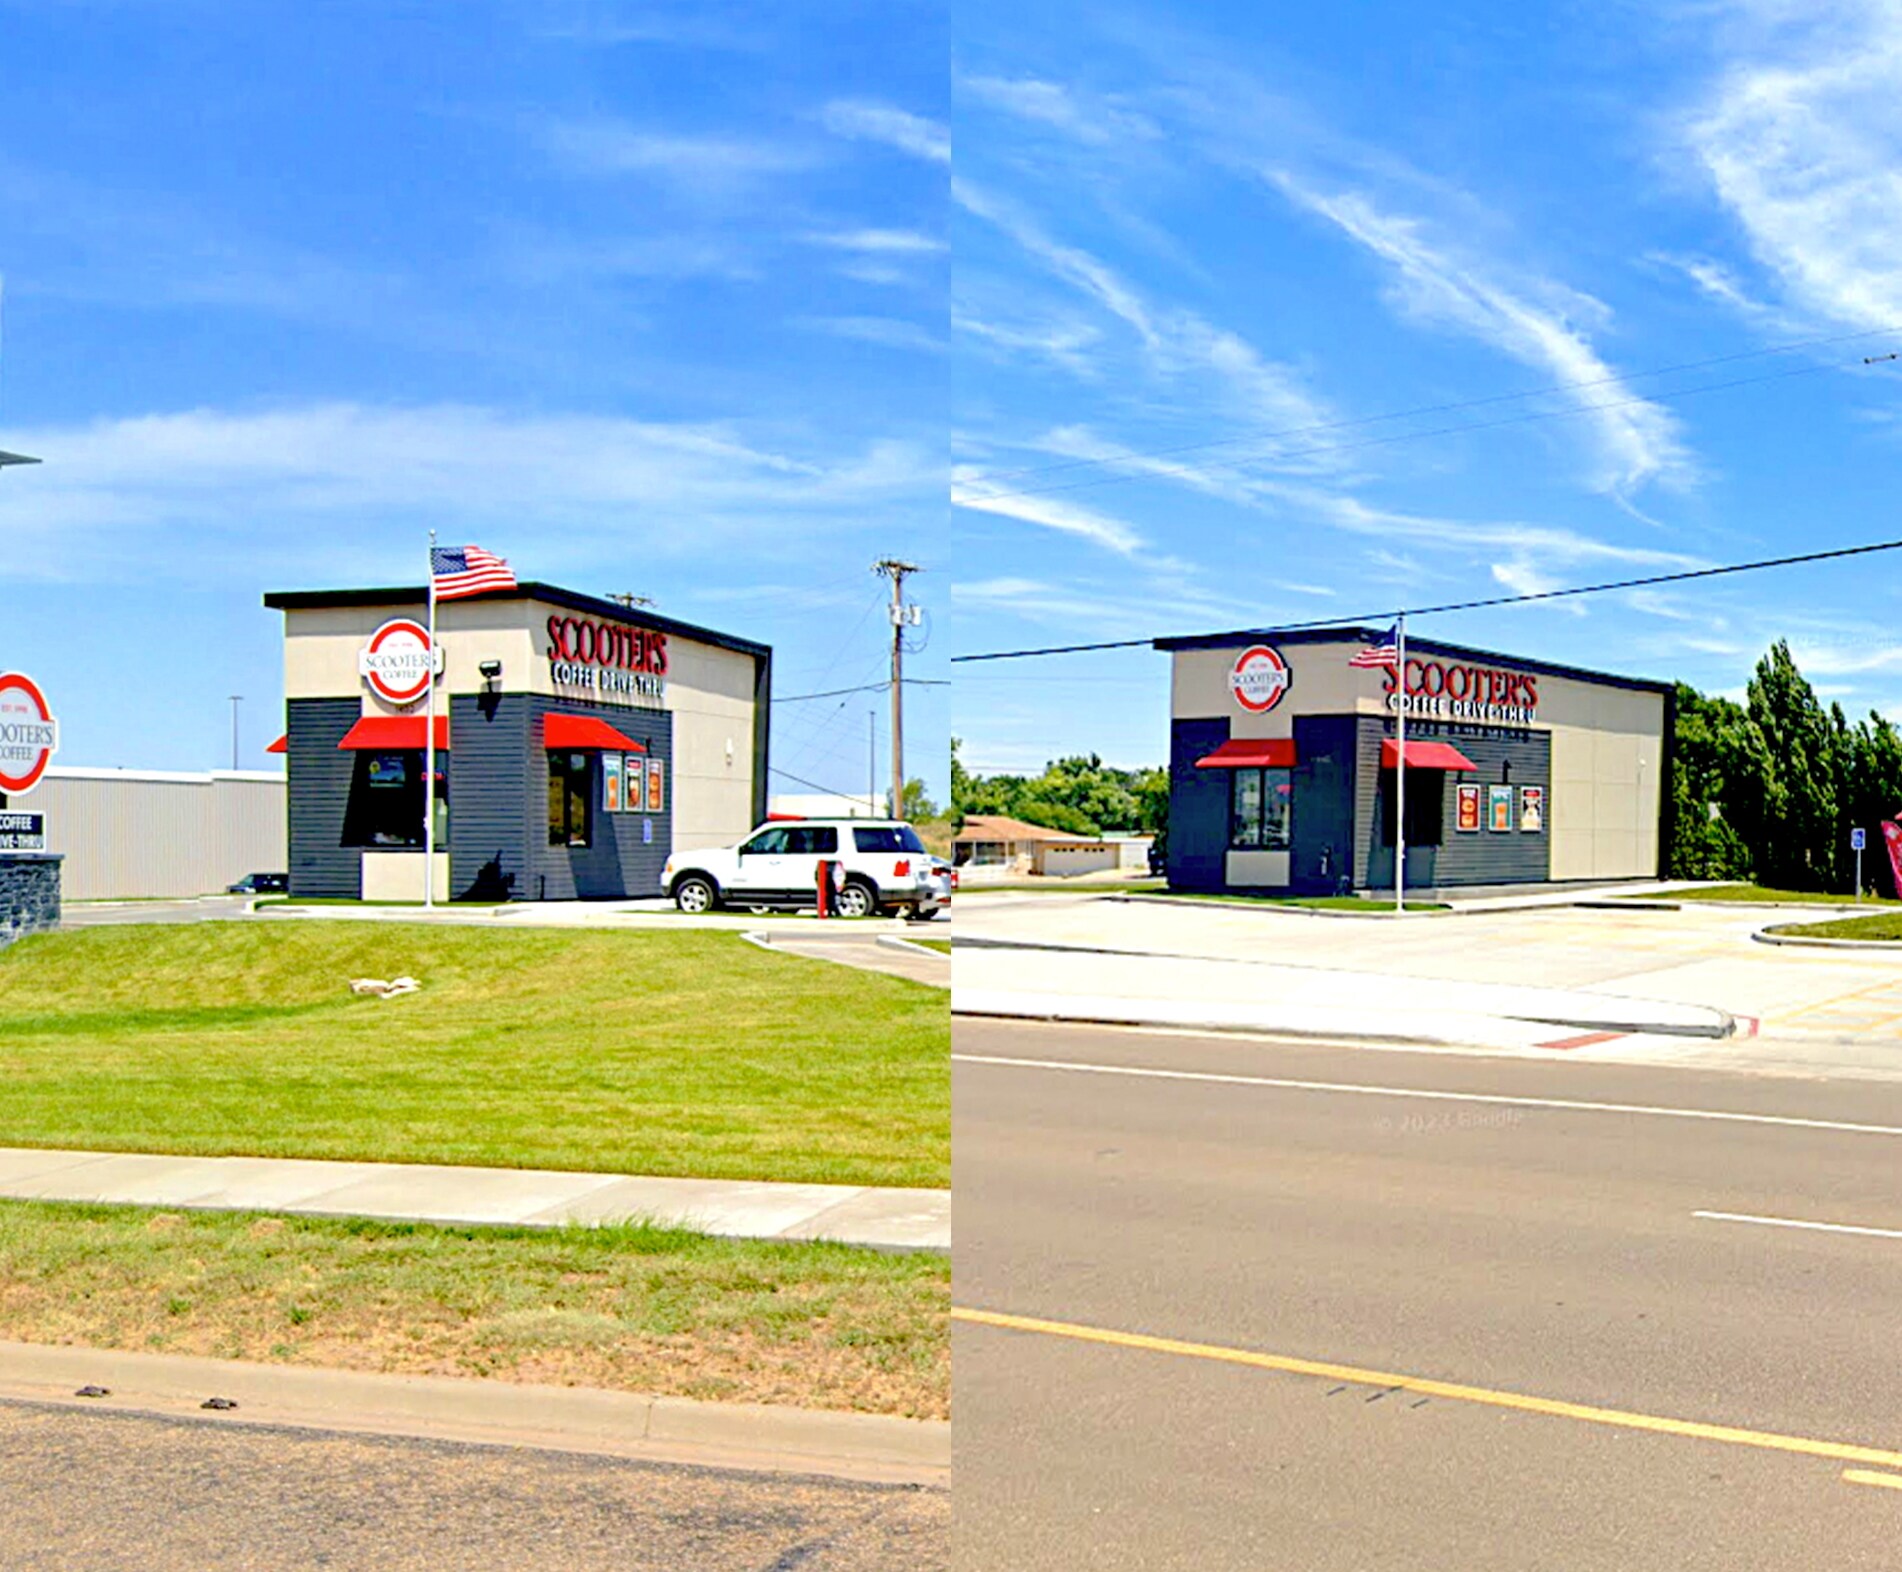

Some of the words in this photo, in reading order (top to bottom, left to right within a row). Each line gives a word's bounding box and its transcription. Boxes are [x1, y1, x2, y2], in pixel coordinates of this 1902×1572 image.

[552, 662, 596, 688] COFFEE
[1387, 693, 1447, 715] COFFEE
[1453, 700, 1537, 723] DRIVE-THRU
